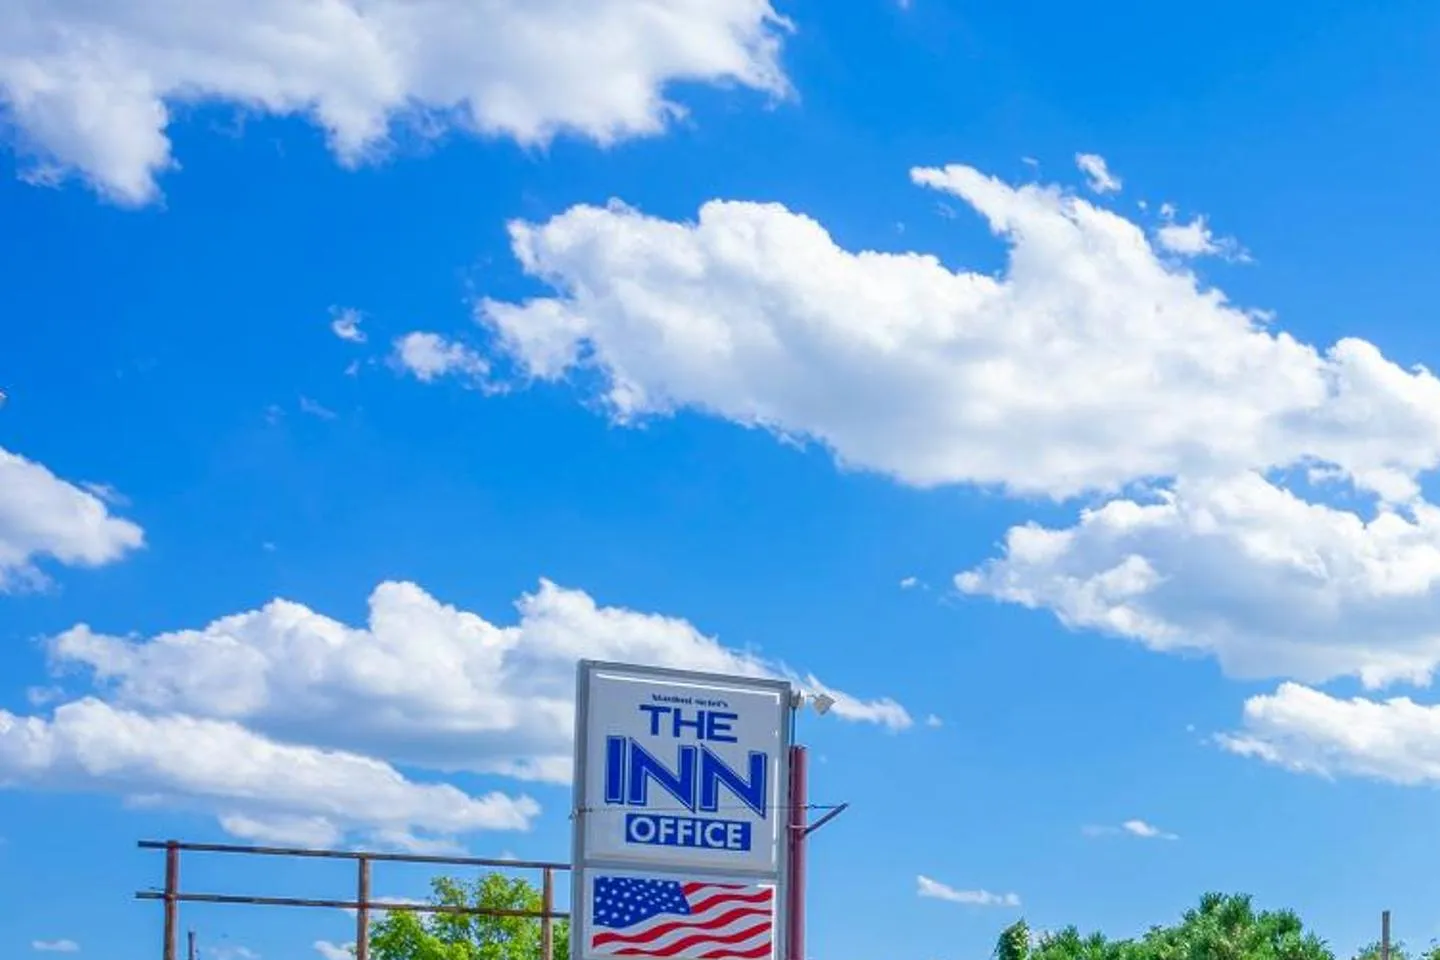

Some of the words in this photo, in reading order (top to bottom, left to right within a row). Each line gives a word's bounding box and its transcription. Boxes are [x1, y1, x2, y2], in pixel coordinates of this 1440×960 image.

[639, 704, 738, 743] THE
[604, 735, 767, 820] INN
[630, 817, 742, 849] OFFICE
